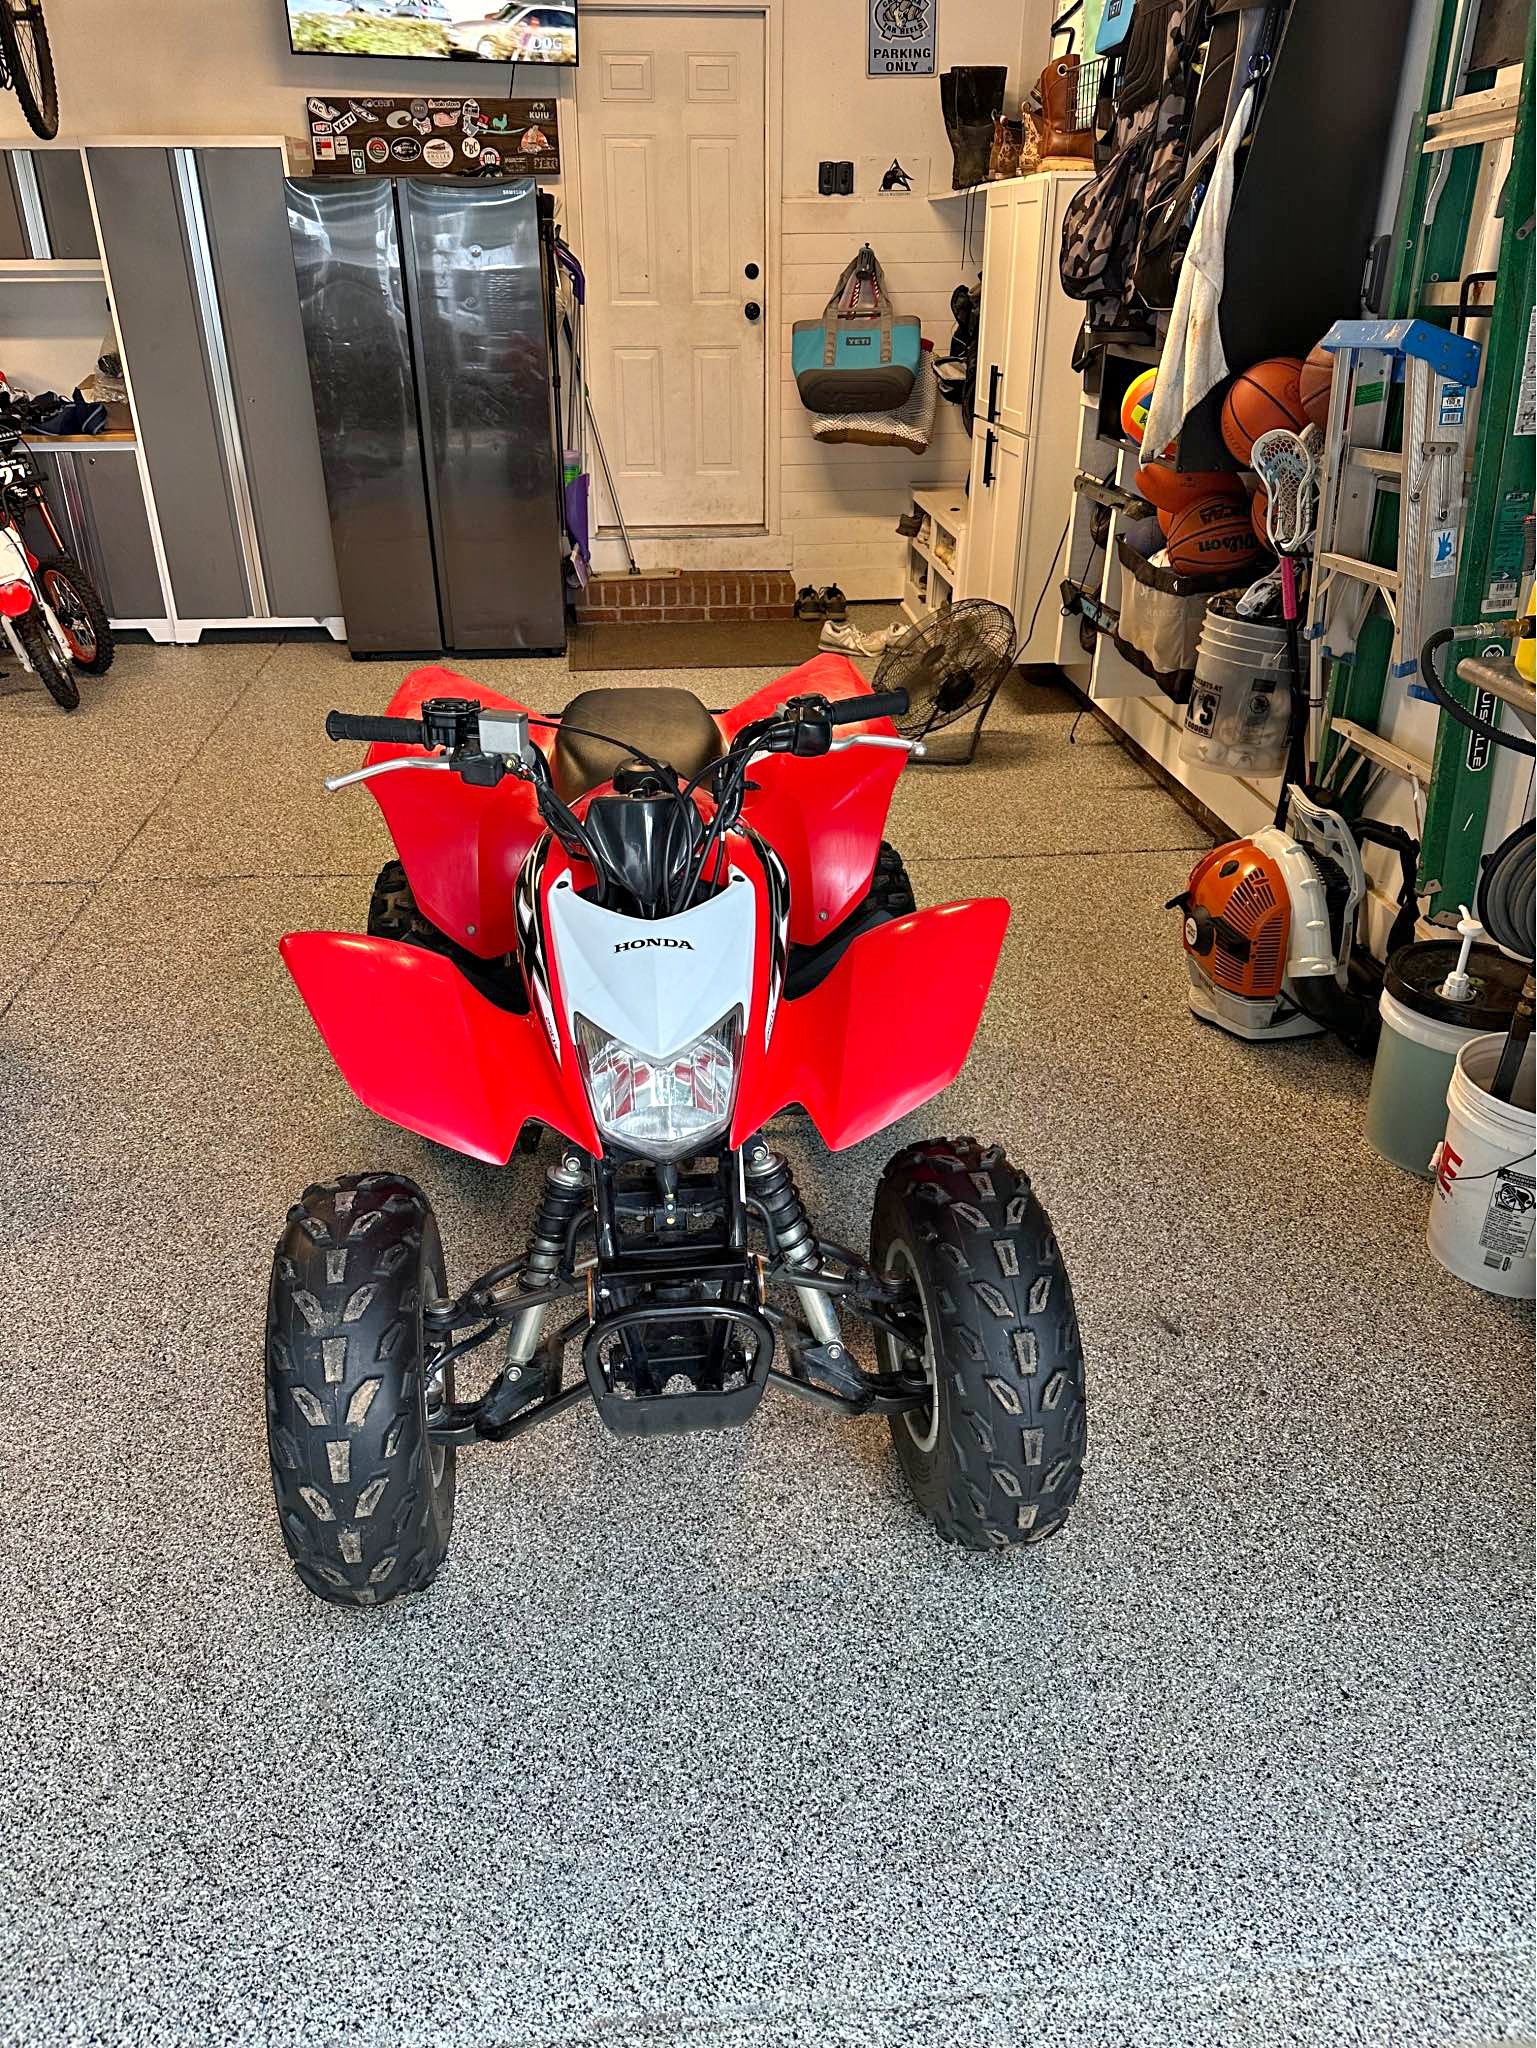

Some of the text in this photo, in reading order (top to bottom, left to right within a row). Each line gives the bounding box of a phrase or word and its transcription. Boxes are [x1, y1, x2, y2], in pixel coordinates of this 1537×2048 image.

[873, 48, 931, 59] PARKING
[885, 61, 919, 71] ONLY
[529, 111, 550, 119] KUIU
[334, 115, 355, 131] YETI
[613, 938, 695, 953] HONDA
